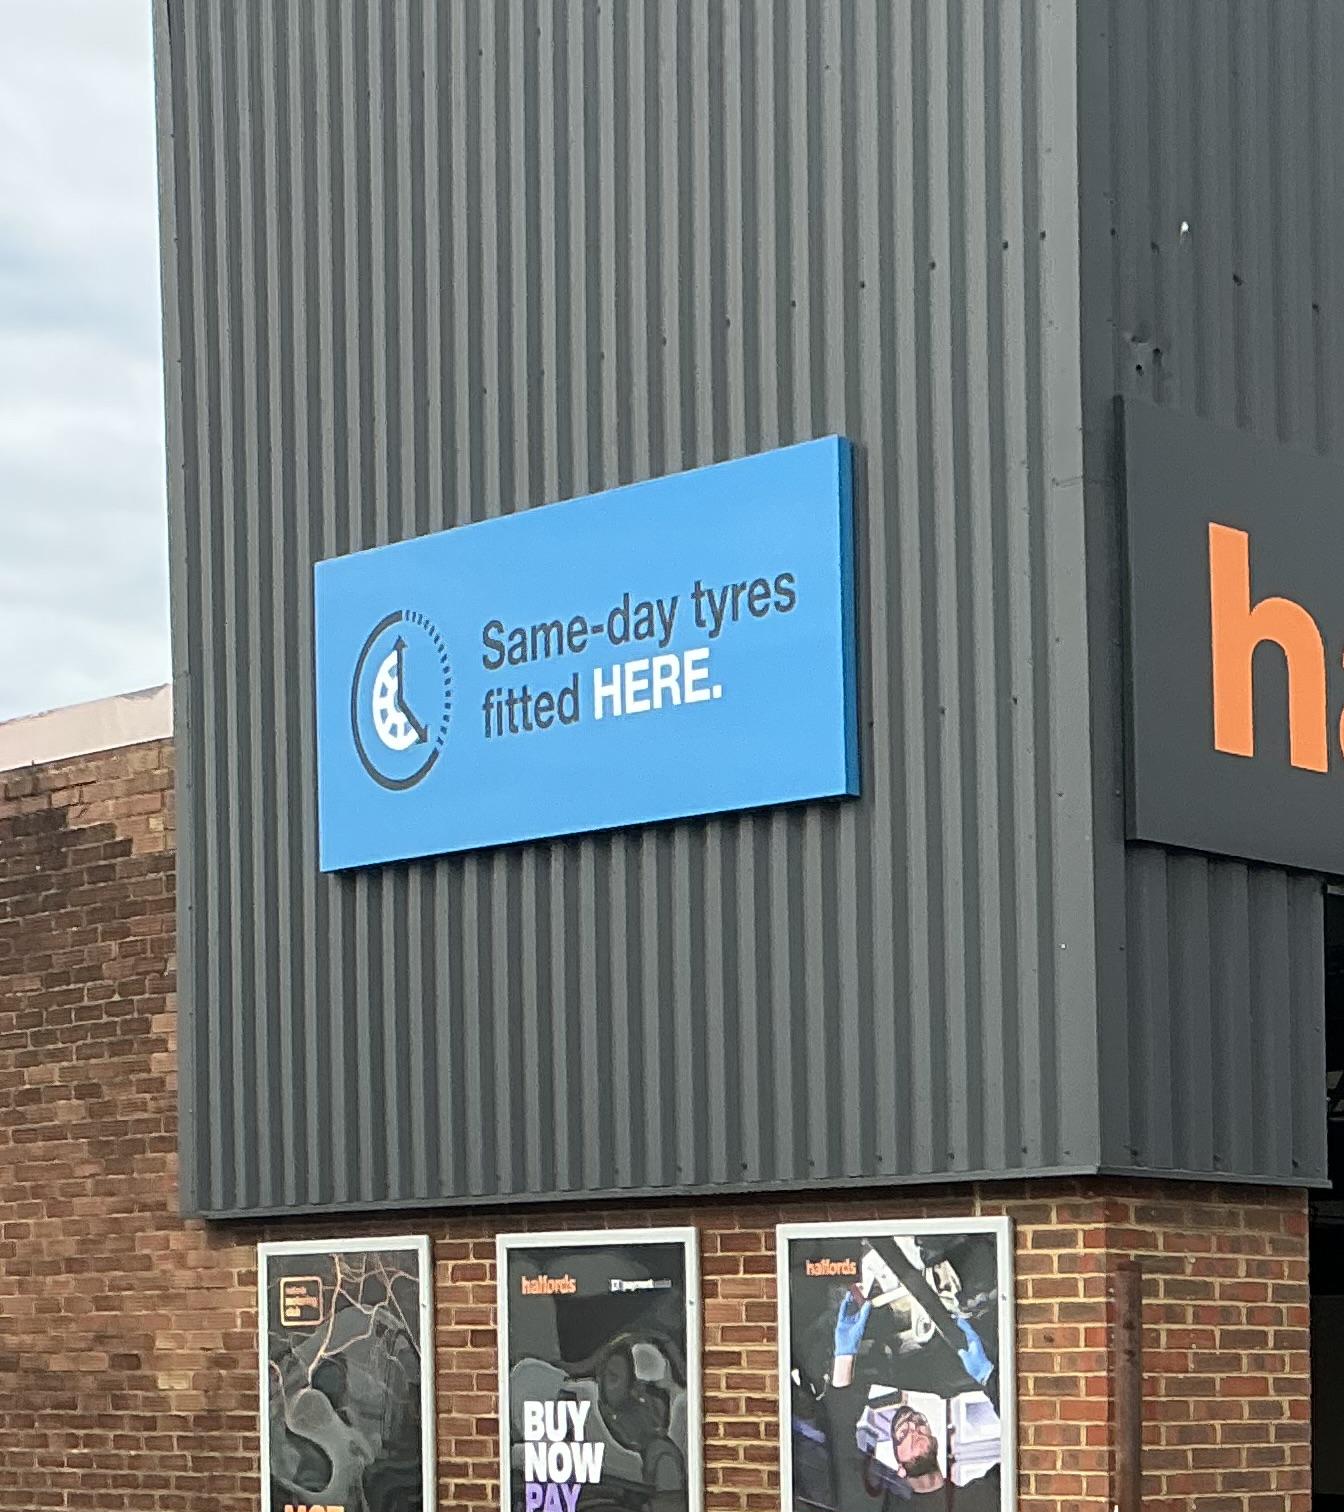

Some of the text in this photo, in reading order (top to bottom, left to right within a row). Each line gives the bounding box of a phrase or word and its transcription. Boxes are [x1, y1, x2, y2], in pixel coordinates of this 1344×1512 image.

[482, 571, 797, 670] Same-day tyres
[482, 648, 722, 738] fitted HERE.
[521, 1274, 577, 1295] halfords
[806, 1257, 857, 1277] halfords
[524, 1400, 591, 1441] BUY
[524, 1442, 605, 1484] NOW
